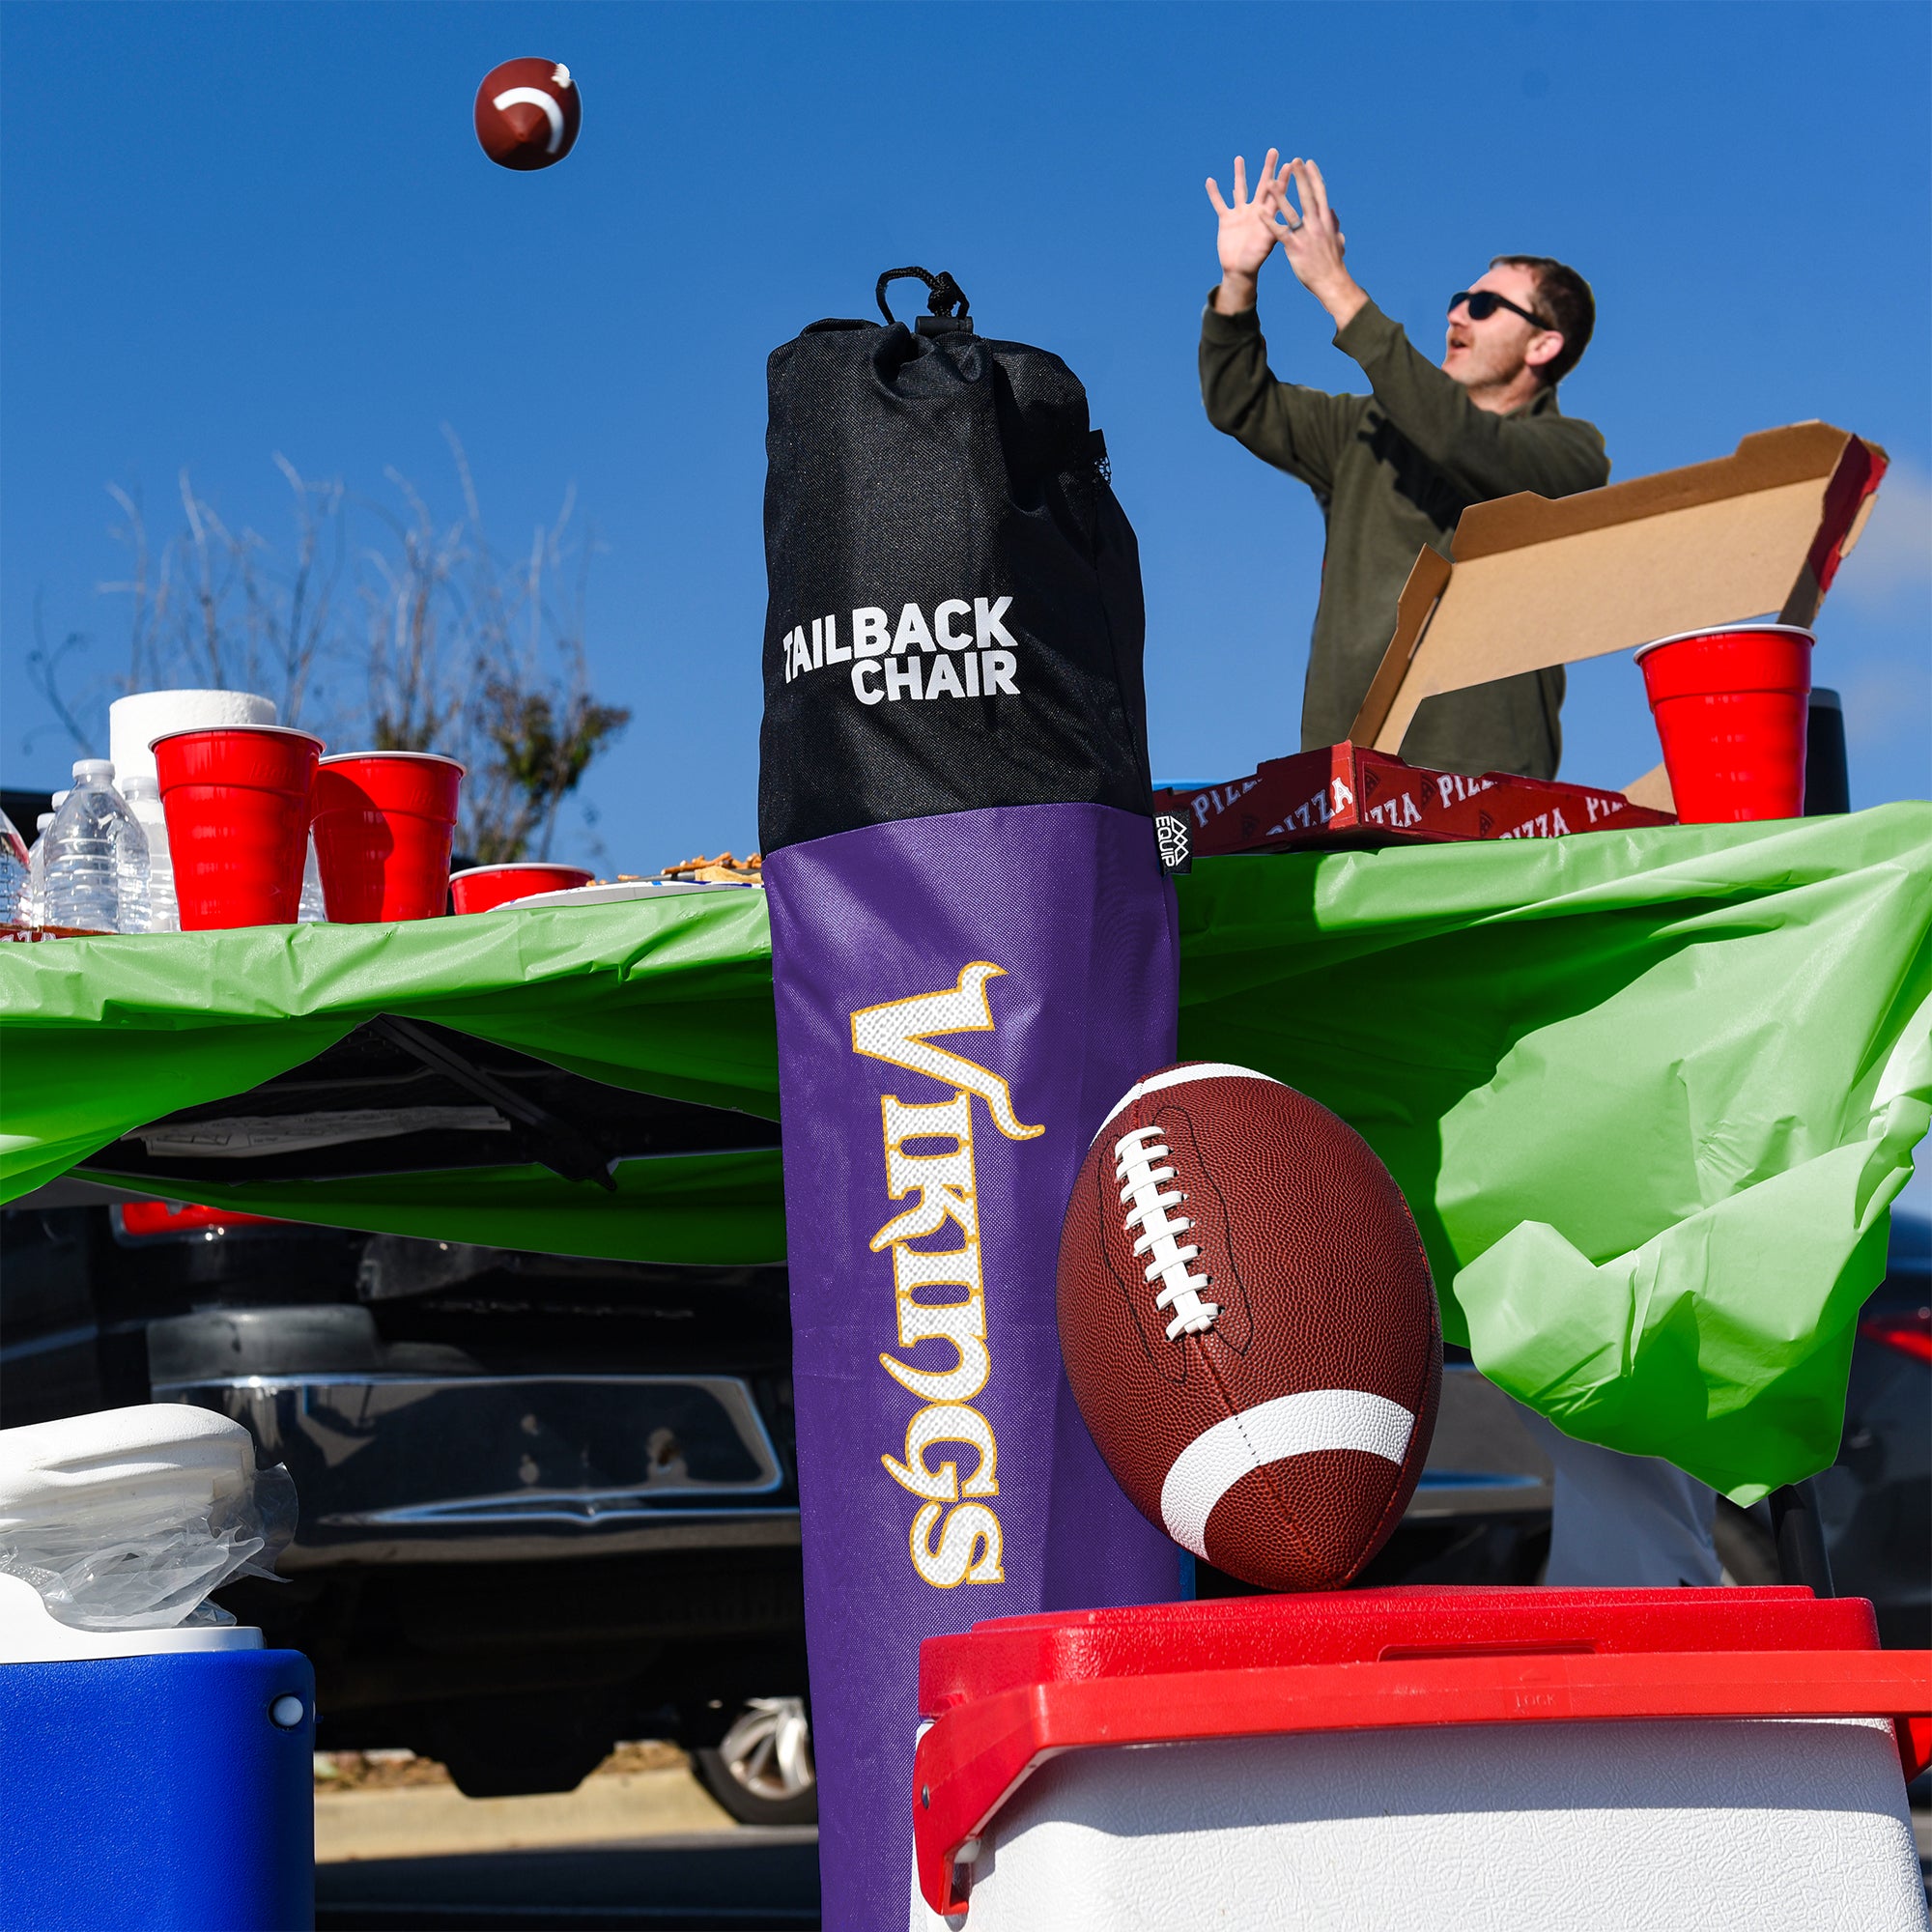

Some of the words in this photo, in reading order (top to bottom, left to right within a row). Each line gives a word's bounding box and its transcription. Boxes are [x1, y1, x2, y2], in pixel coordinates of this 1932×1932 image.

[782, 595, 1019, 684] TAILBACK
[850, 650, 1021, 706] CHAIR
[1191, 778, 1263, 828] PIZ
[1364, 792, 1422, 828] ZZA
[1436, 774, 1497, 809] PIZ
[1155, 815, 1176, 867] EQUIP
